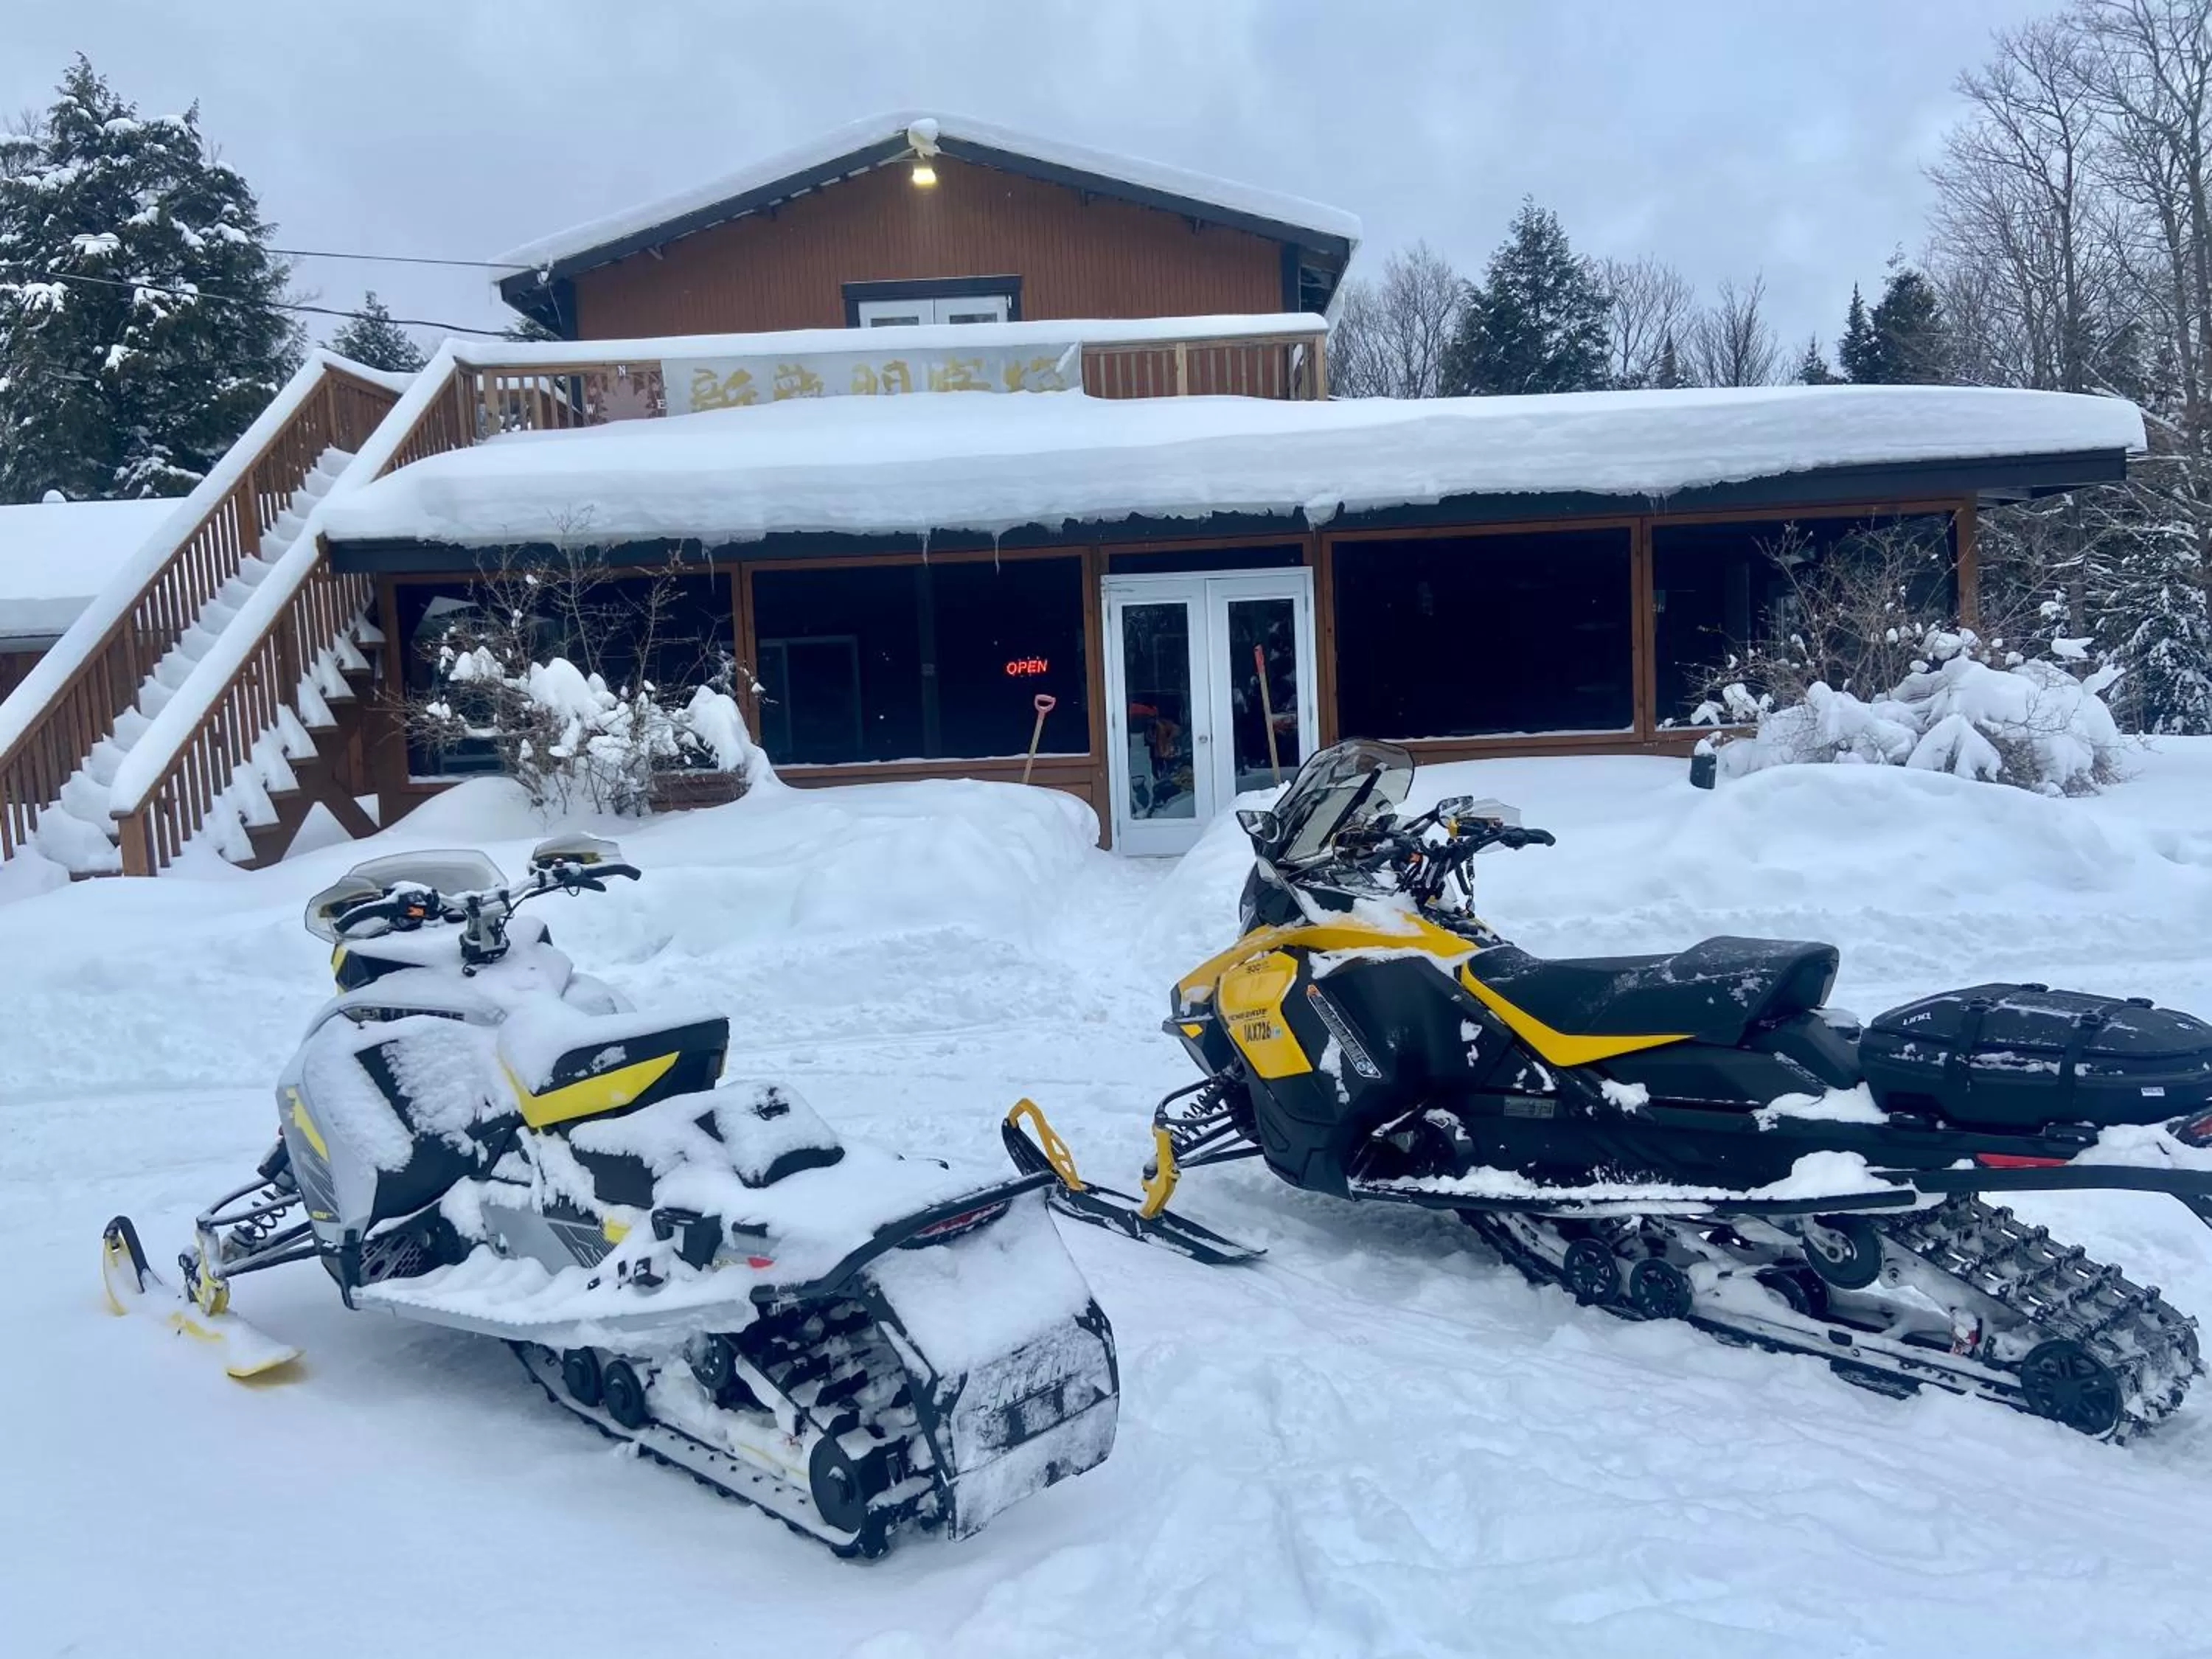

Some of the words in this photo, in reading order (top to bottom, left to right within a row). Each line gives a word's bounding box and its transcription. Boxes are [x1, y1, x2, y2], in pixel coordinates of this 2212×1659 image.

[617, 365, 626, 376] N
[585, 403, 596, 414] W
[656, 399, 667, 409] E
[1006, 660, 1048, 675] OPEN
